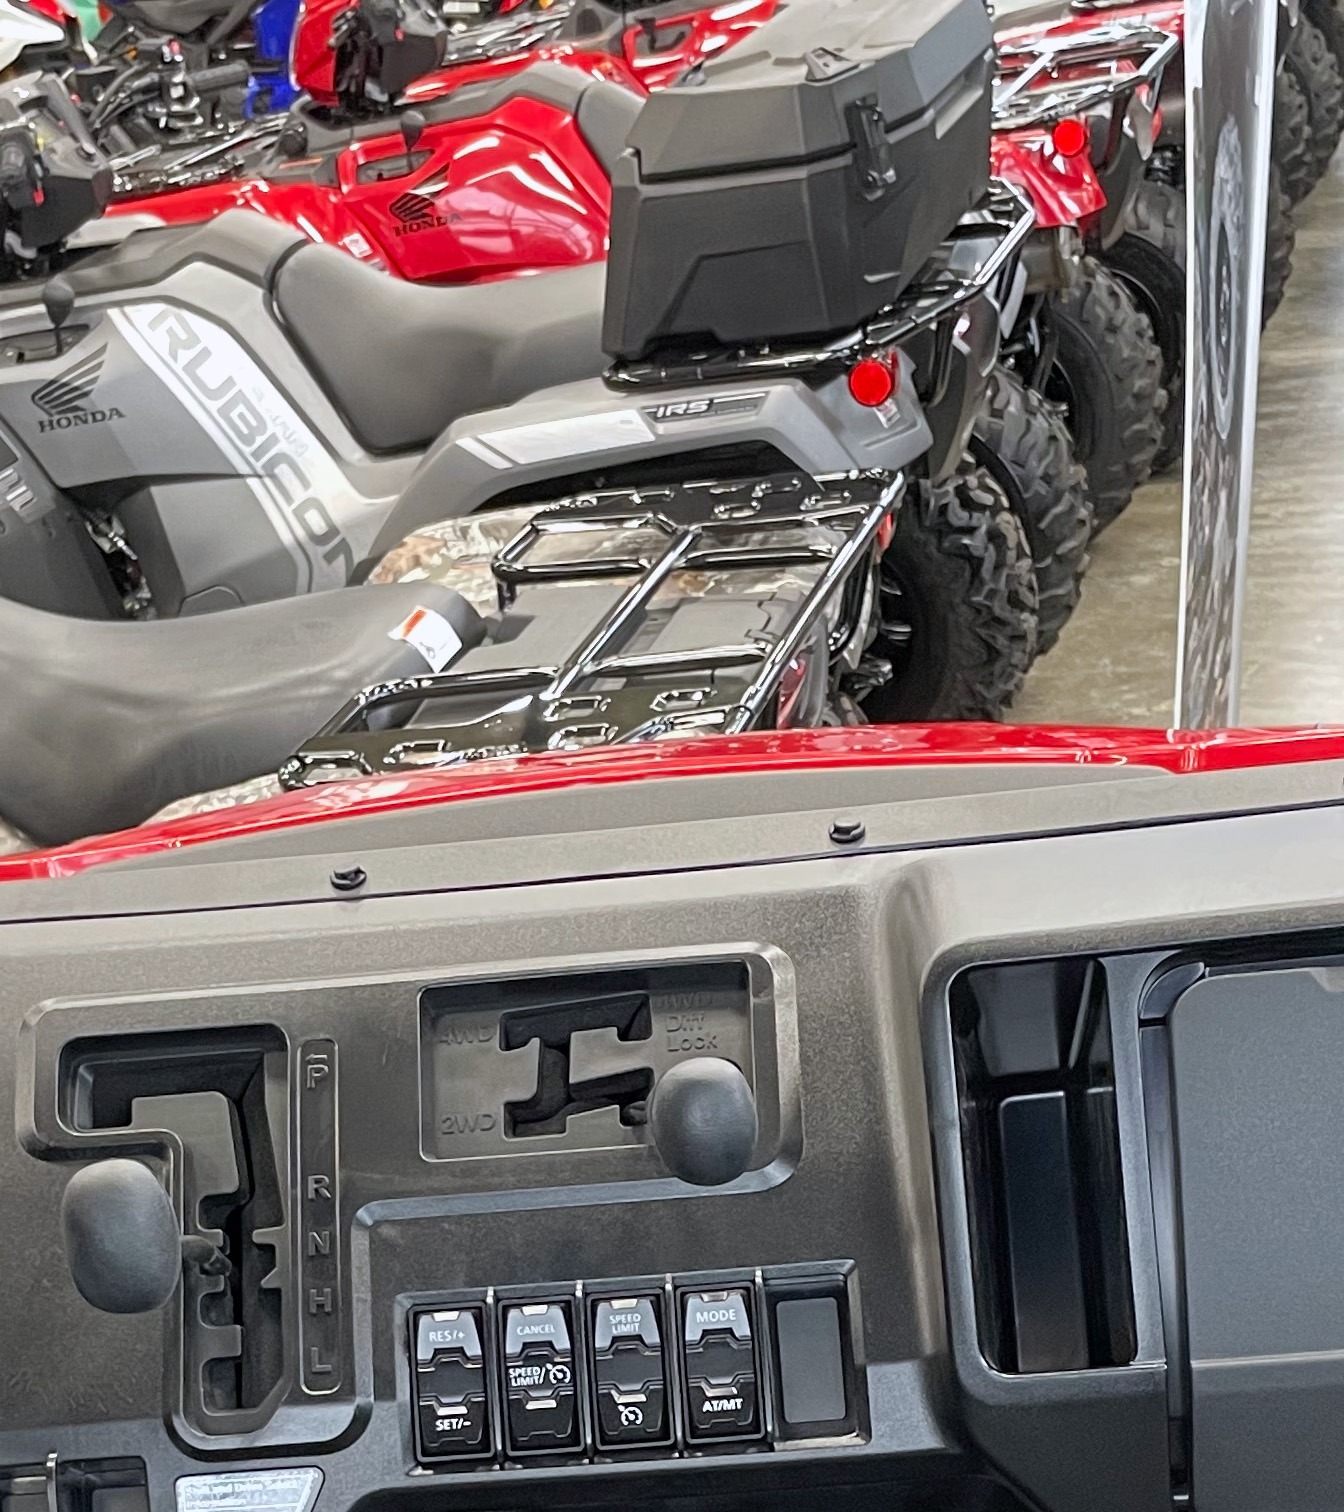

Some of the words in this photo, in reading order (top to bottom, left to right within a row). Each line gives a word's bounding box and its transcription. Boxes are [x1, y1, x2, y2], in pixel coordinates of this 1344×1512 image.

[656, 400, 711, 418] IRS
[38, 407, 126, 434] HONDA
[667, 1035, 718, 1053] Lock
[307, 1064, 329, 1089] P
[441, 1114, 497, 1136] 2WD
[308, 1174, 332, 1200] R
[308, 1231, 330, 1256] N
[310, 1288, 332, 1314] H
[609, 1313, 641, 1324] SPEED
[696, 1309, 737, 1323] MODE
[429, 1329, 465, 1342] RES/+
[517, 1324, 556, 1336] CANCEL
[612, 1323, 640, 1334] LIMIT
[311, 1347, 332, 1374] L
[508, 1366, 540, 1378] SPEED
[702, 1398, 743, 1413] AT/MT
